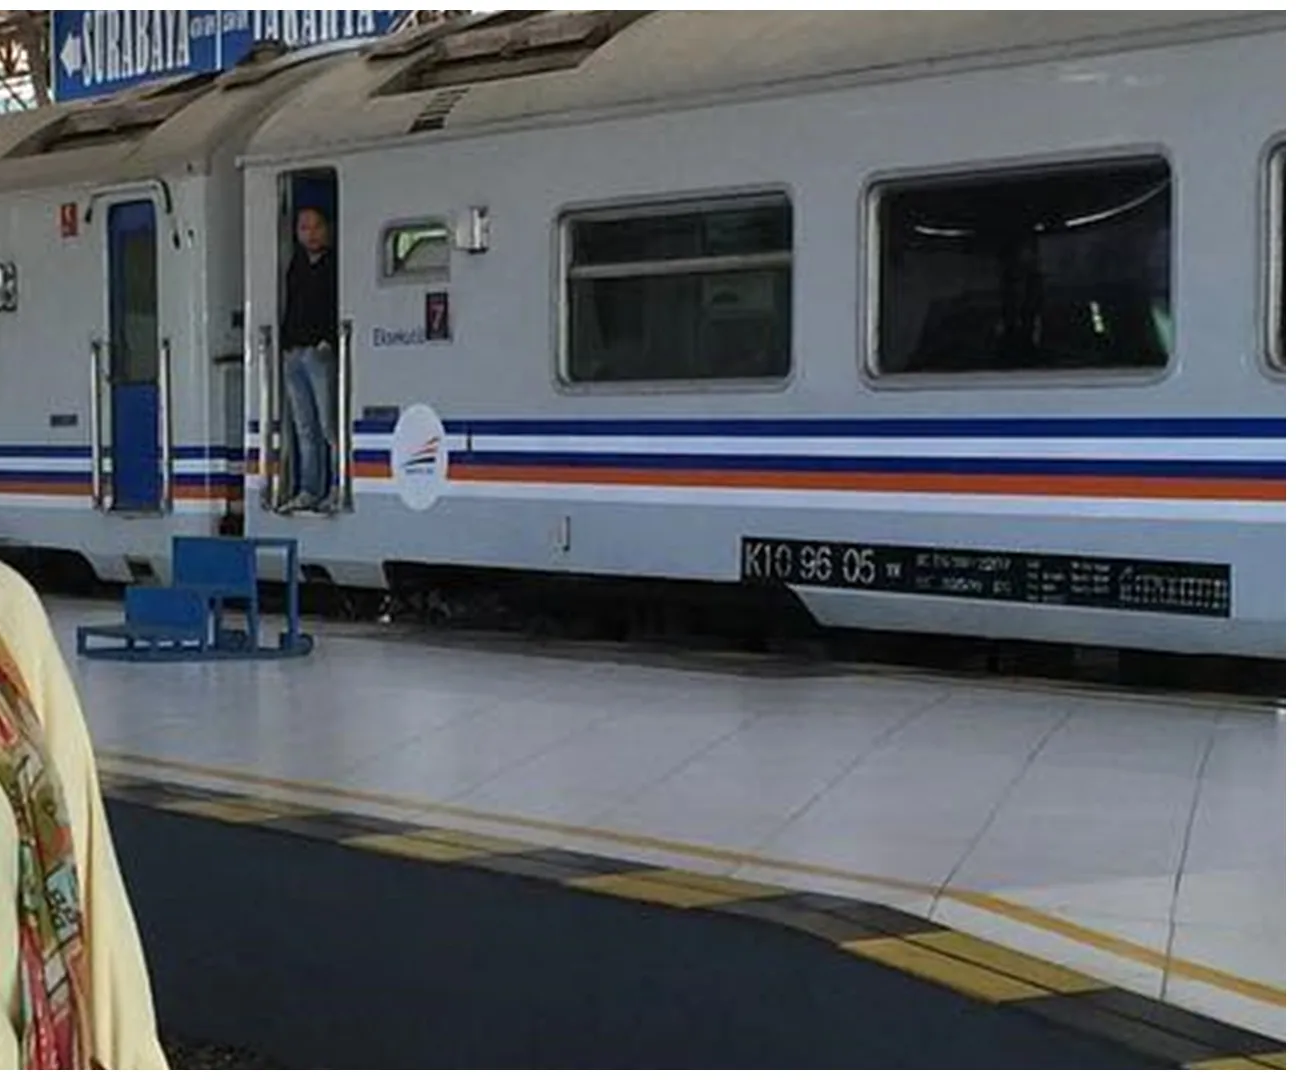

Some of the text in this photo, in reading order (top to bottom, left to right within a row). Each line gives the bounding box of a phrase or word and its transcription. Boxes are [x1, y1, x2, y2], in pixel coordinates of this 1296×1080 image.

[83, 10, 190, 86] SURABAYA
[431, 302, 445, 332] 7
[745, 542, 792, 578] K10
[800, 546, 832, 581] 96
[843, 548, 876, 584] 05
